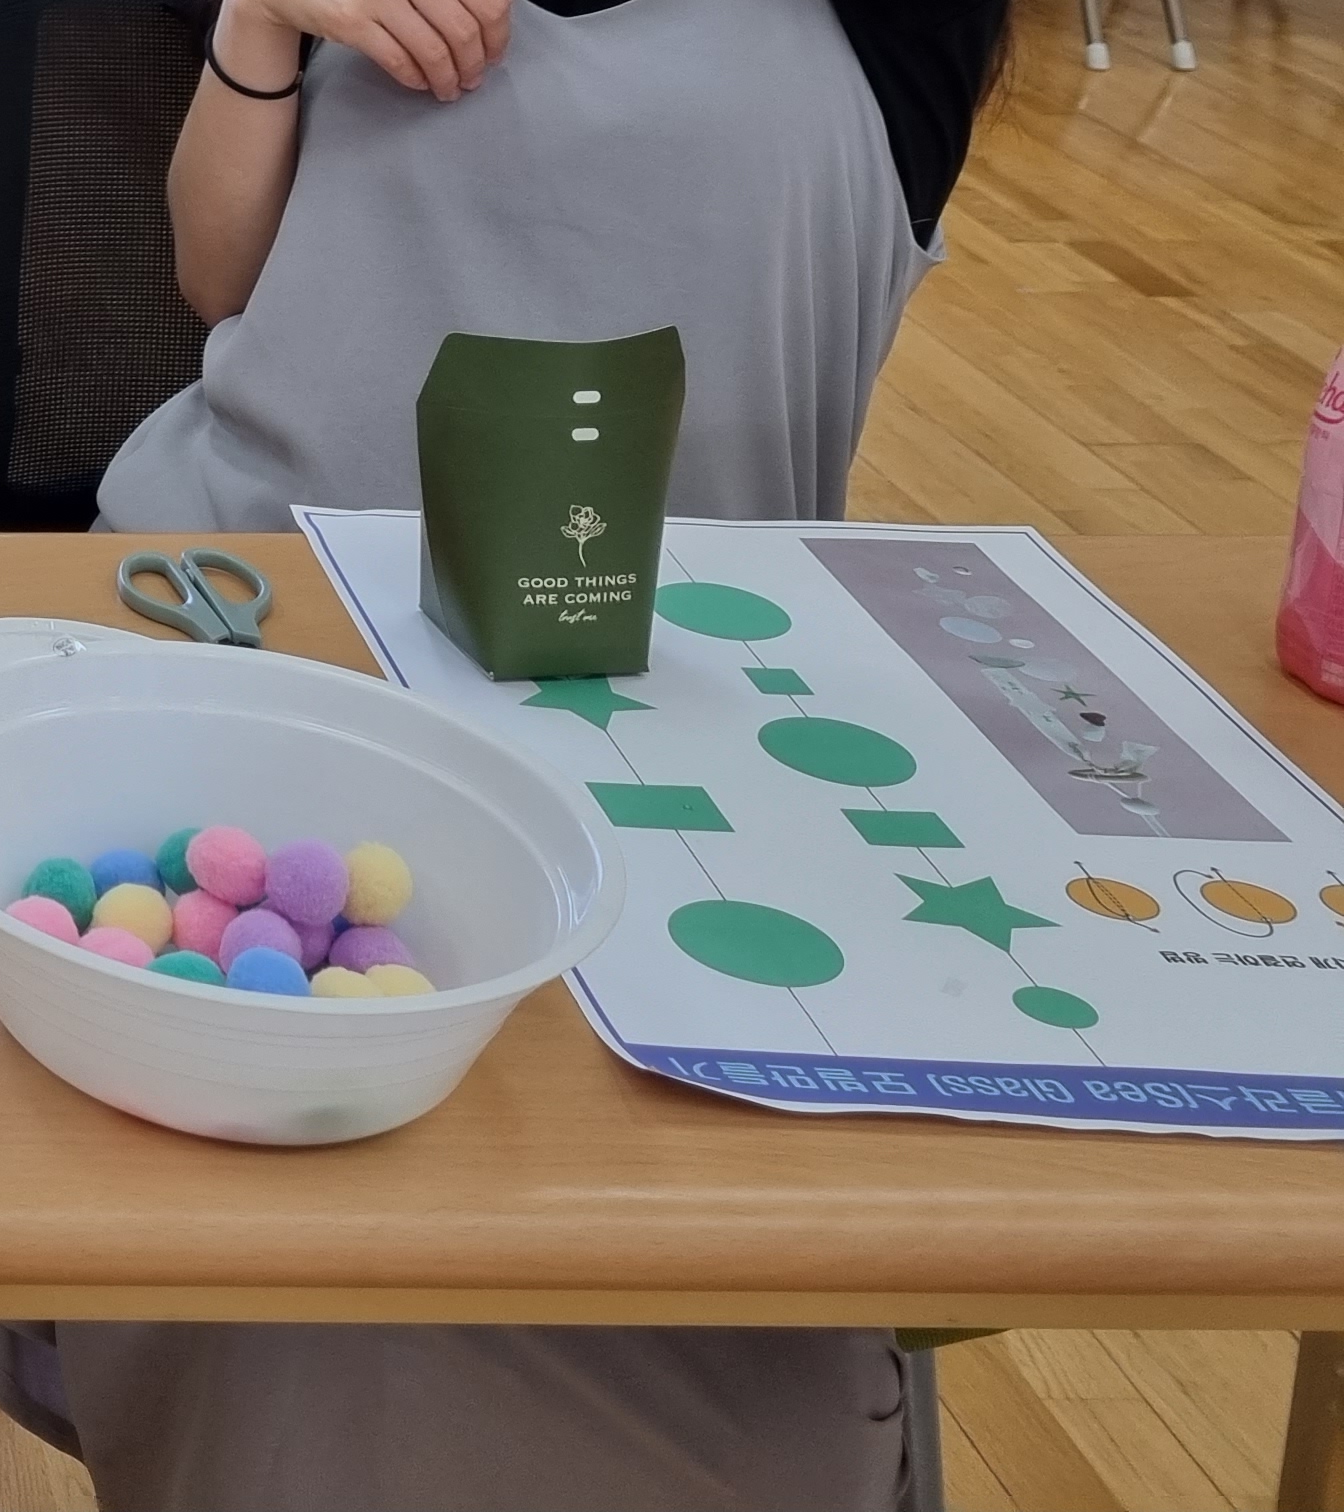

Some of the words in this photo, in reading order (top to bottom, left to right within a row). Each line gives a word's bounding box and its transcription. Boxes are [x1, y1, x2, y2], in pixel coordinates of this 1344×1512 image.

[517, 577, 569, 588] GOOD
[574, 573, 637, 587] THINGS
[523, 593, 558, 605] ARE
[564, 590, 632, 604] COMING
[1158, 950, 1209, 965] 방법
[1211, 952, 1307, 969] 연결하는
[667, 1056, 918, 1096] 모빌만들기
[926, 1072, 1076, 1104] Glass)
[1082, 1079, 1344, 1116] 글라스(Sea
